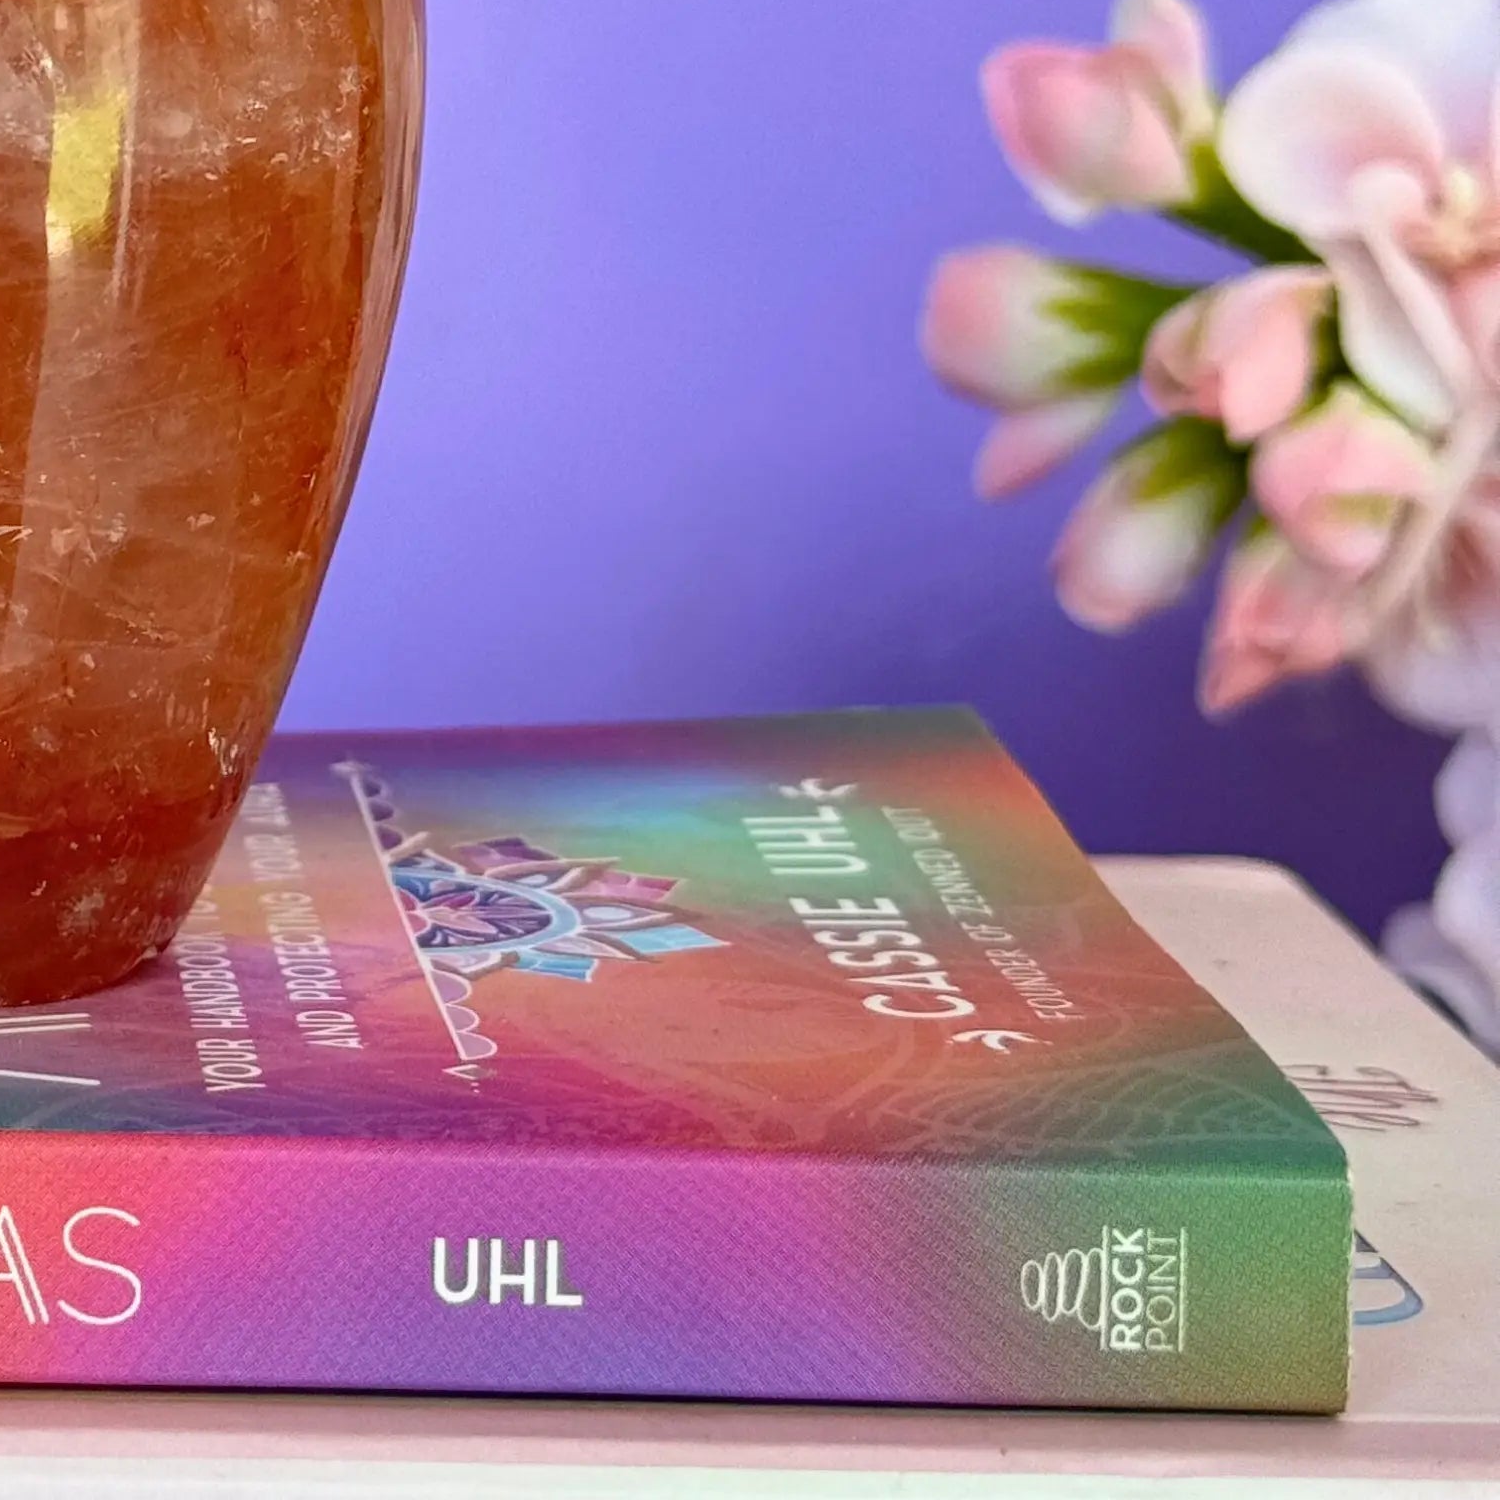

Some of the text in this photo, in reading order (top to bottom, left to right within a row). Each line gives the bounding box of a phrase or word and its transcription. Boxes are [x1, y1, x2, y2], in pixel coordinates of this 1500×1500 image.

[243, 833, 306, 882] YOUR
[259, 892, 346, 1001] PROTECTING
[742, 805, 976, 1018] CASSIE UHL
[881, 805, 1085, 1020] FOUNDER OF ZENNED OUT
[173, 931, 249, 1028] HANDBOOK
[296, 1010, 363, 1049] AND
[196, 1038, 266, 1092] YOUR
[431, 1236, 584, 1307] UHL
[1109, 1228, 1144, 1350] ROCK
[1145, 1228, 1178, 1351] POINT
